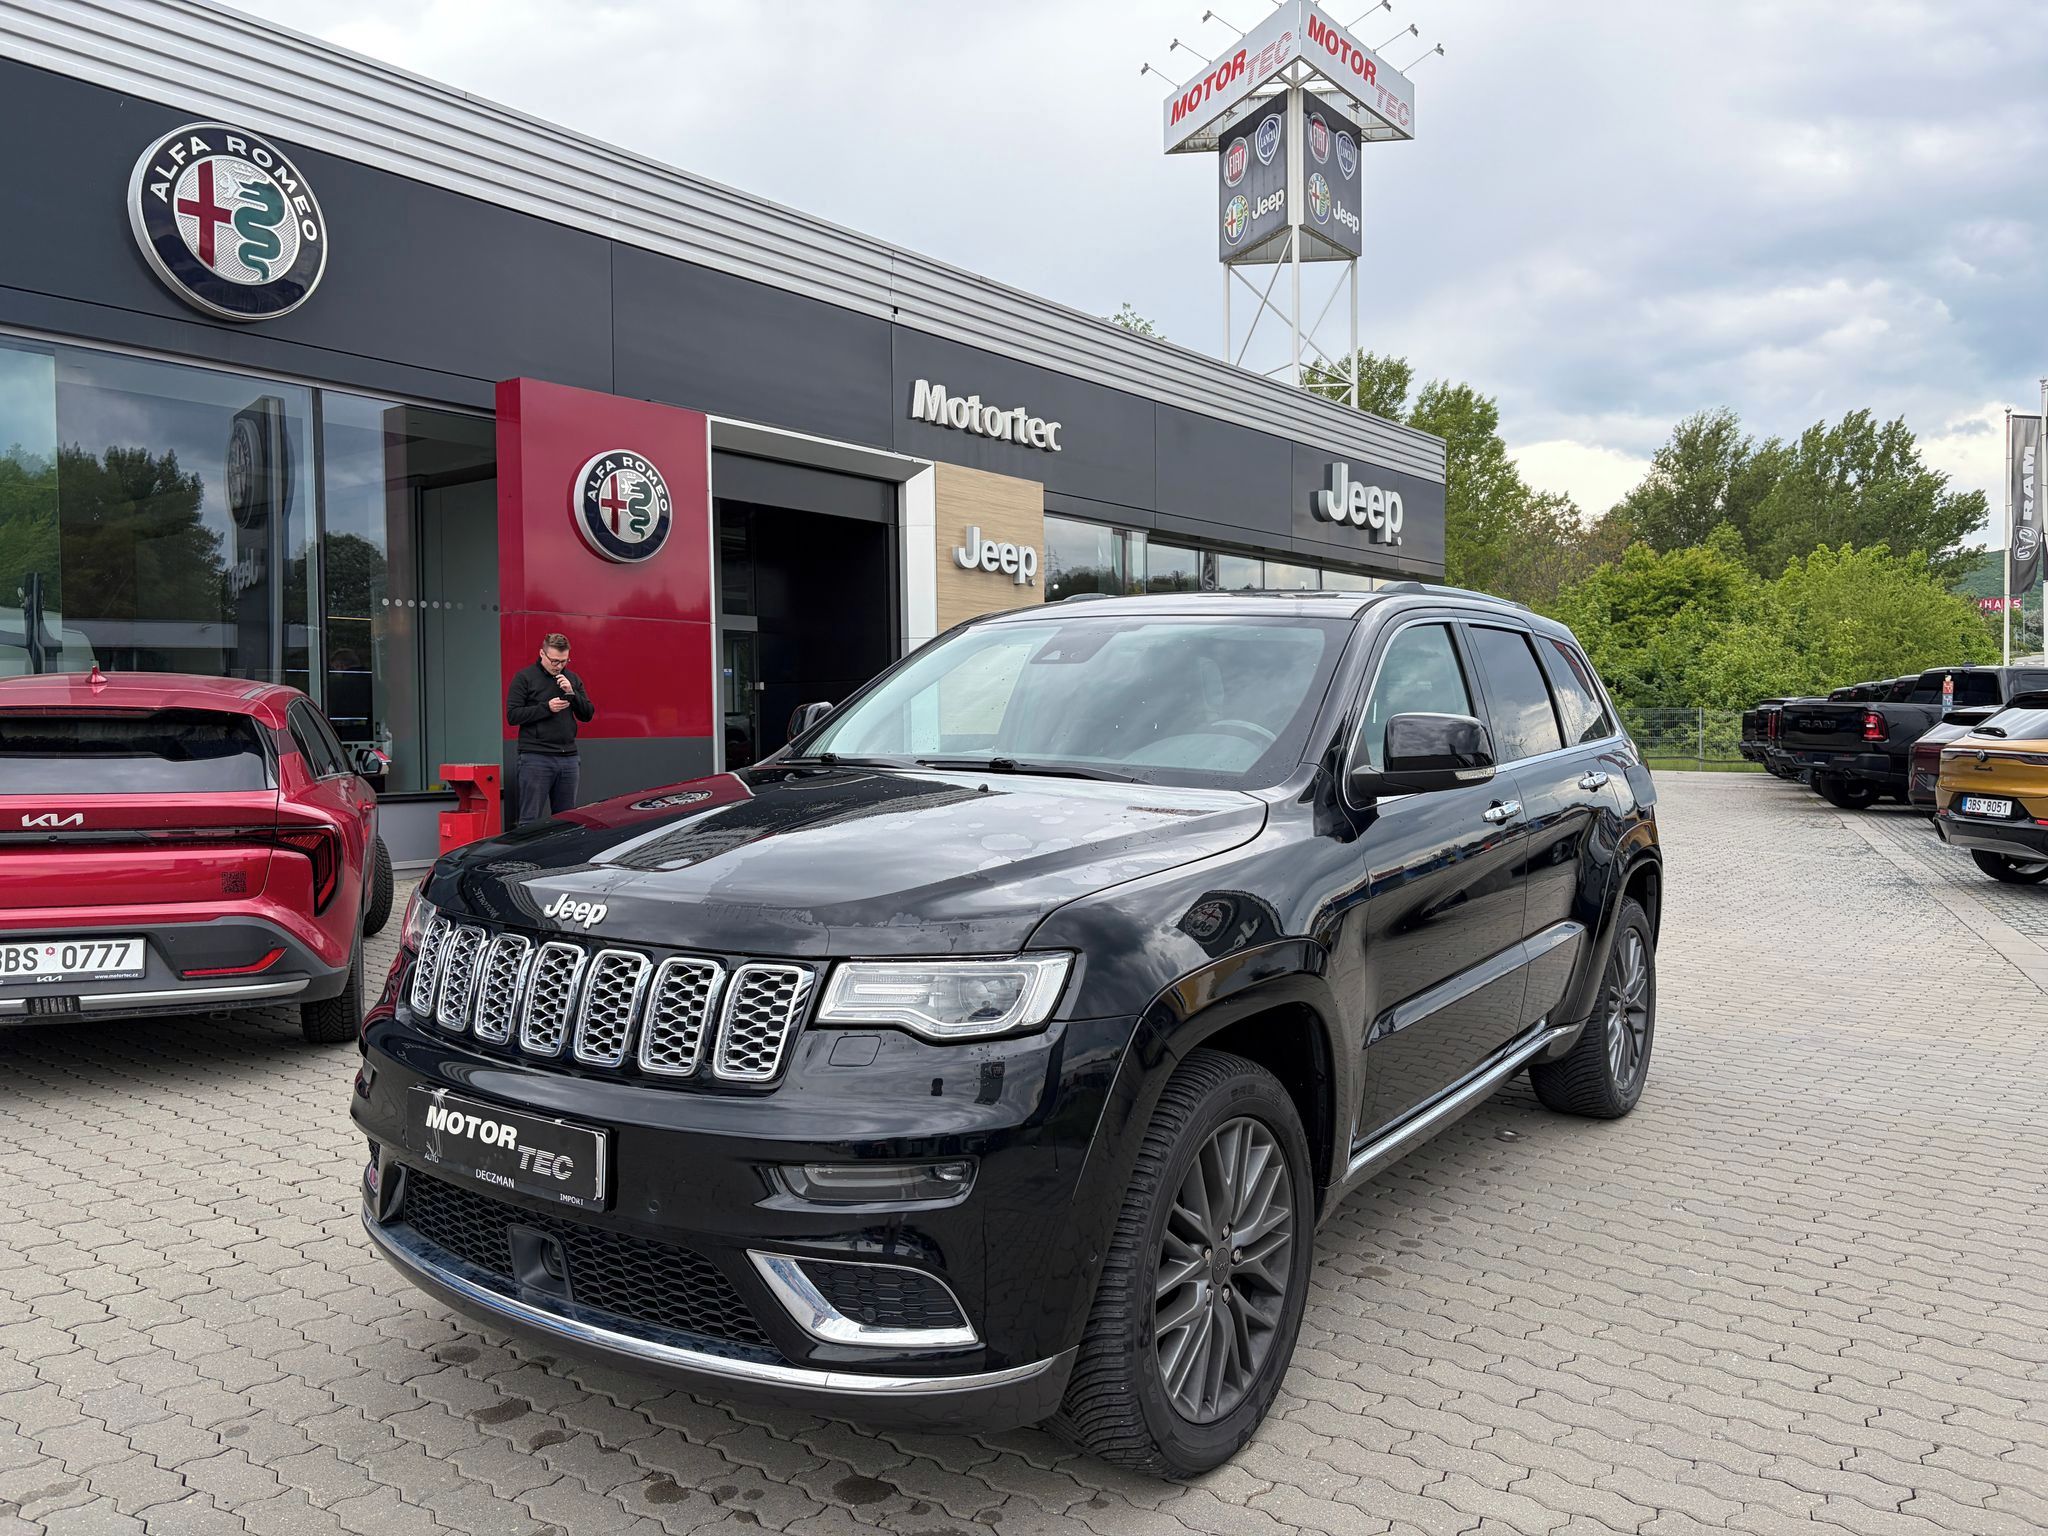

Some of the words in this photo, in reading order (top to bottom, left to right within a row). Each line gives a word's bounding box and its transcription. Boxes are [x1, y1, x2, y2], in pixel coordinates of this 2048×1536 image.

[1170, 49, 1247, 126] MOTOR
[1245, 31, 1293, 86] TEC
[1307, 13, 1377, 87] MOTOR
[1375, 82, 1409, 127] TEC
[1312, 123, 1326, 153] FIAT
[1229, 148, 1245, 178] FIAT
[150, 136, 212, 204] ALFA
[226, 135, 317, 242] ROMEO
[1252, 189, 1285, 220] Jeep
[1333, 200, 1359, 235] Jeep
[910, 378, 1062, 453] Motortec
[587, 460, 616, 502] ALFA
[622, 456, 668, 511] ROMEO
[2022, 446, 2036, 521] RAM
[1316, 462, 1404, 544] Jeep
[953, 525, 1038, 585] Jeep
[1979, 599, 2021, 609] HAS
[1799, 719, 1837, 730] RAM
[1967, 799, 1982, 811] 3BS
[1986, 800, 2008, 814] 8051
[543, 892, 609, 930] Jeep
[61, 943, 131, 970] 0777
[425, 1105, 518, 1150] MOTOR
[517, 1144, 574, 1180] TEC
[475, 1168, 515, 1188] DECZMAN
[559, 1193, 584, 1205] IMPORT
